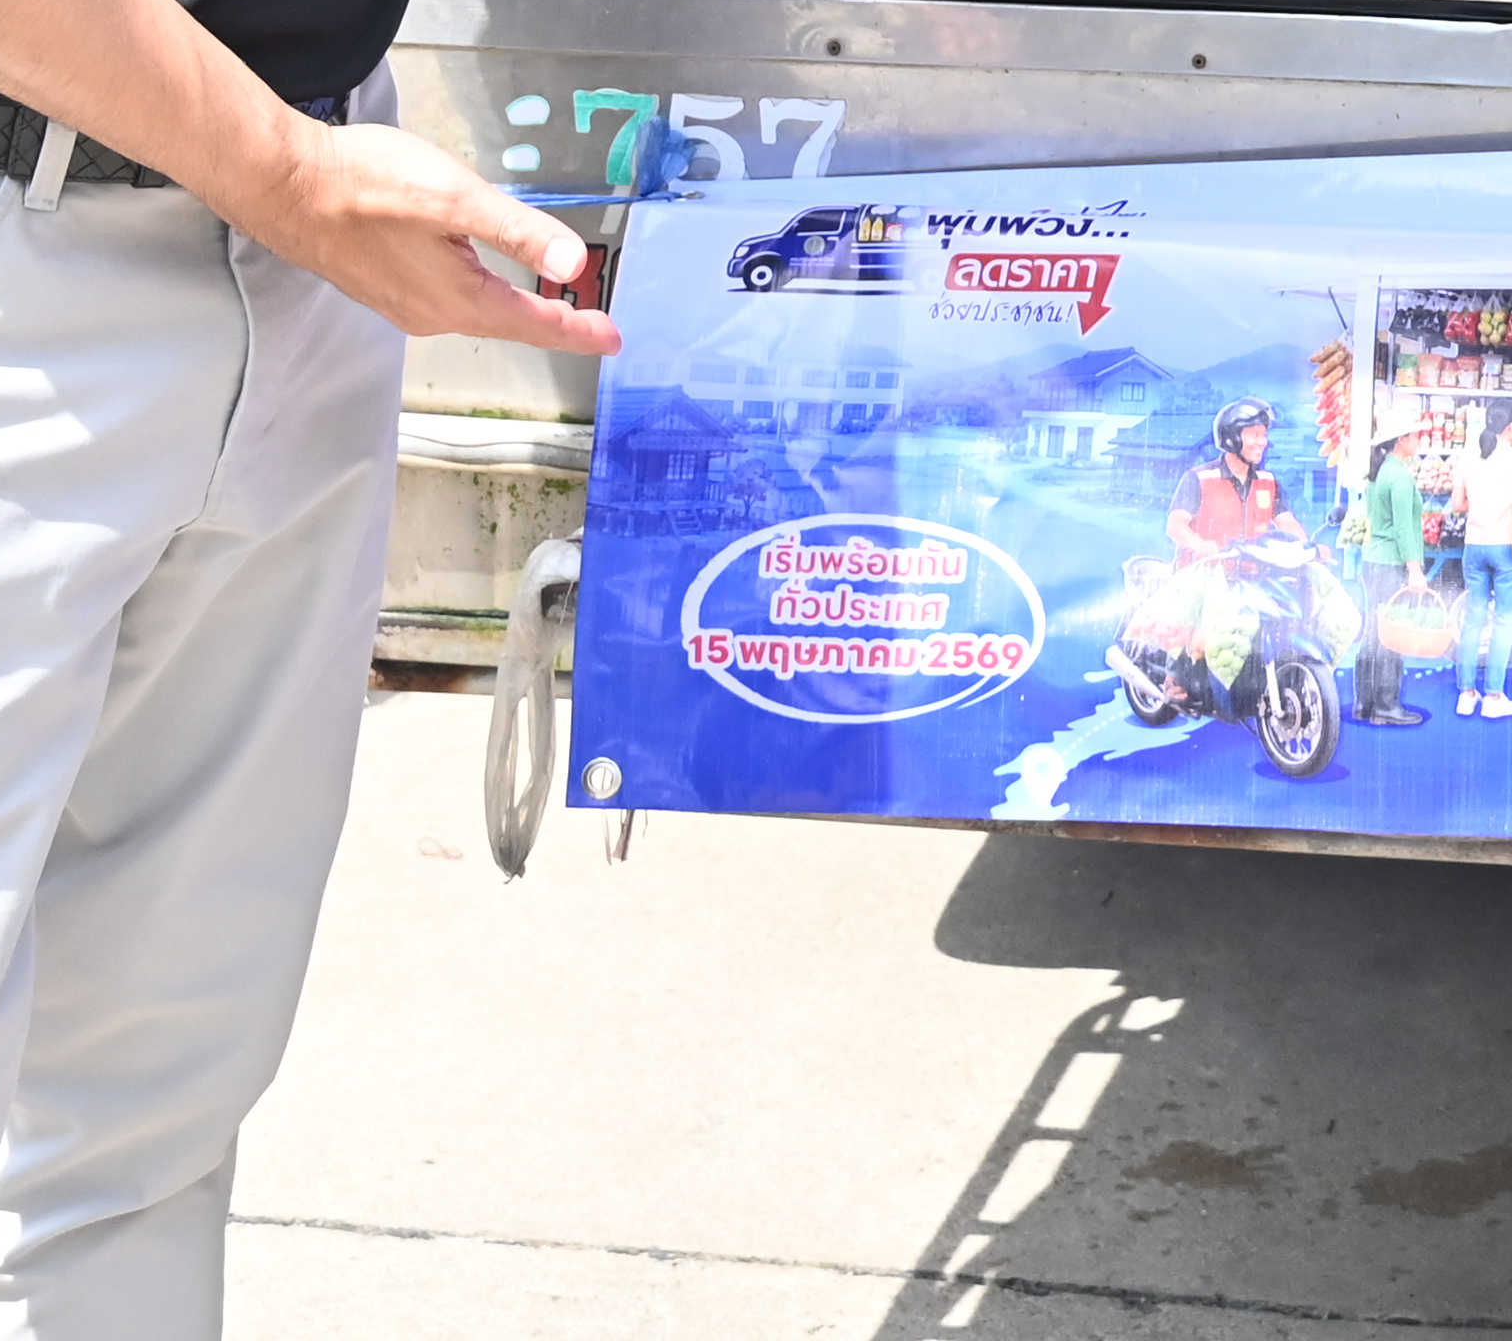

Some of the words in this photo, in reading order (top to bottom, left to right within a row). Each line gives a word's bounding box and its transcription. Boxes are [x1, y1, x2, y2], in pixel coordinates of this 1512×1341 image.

[953, 257, 1099, 289] ลดราคา
[765, 536, 961, 577] เริ่มพร้อมกัน
[775, 579, 943, 622] ทั่วประเทศ
[689, 635, 729, 665] 15
[738, 640, 917, 674] พฤษภาคม
[926, 640, 1024, 671] 2569
